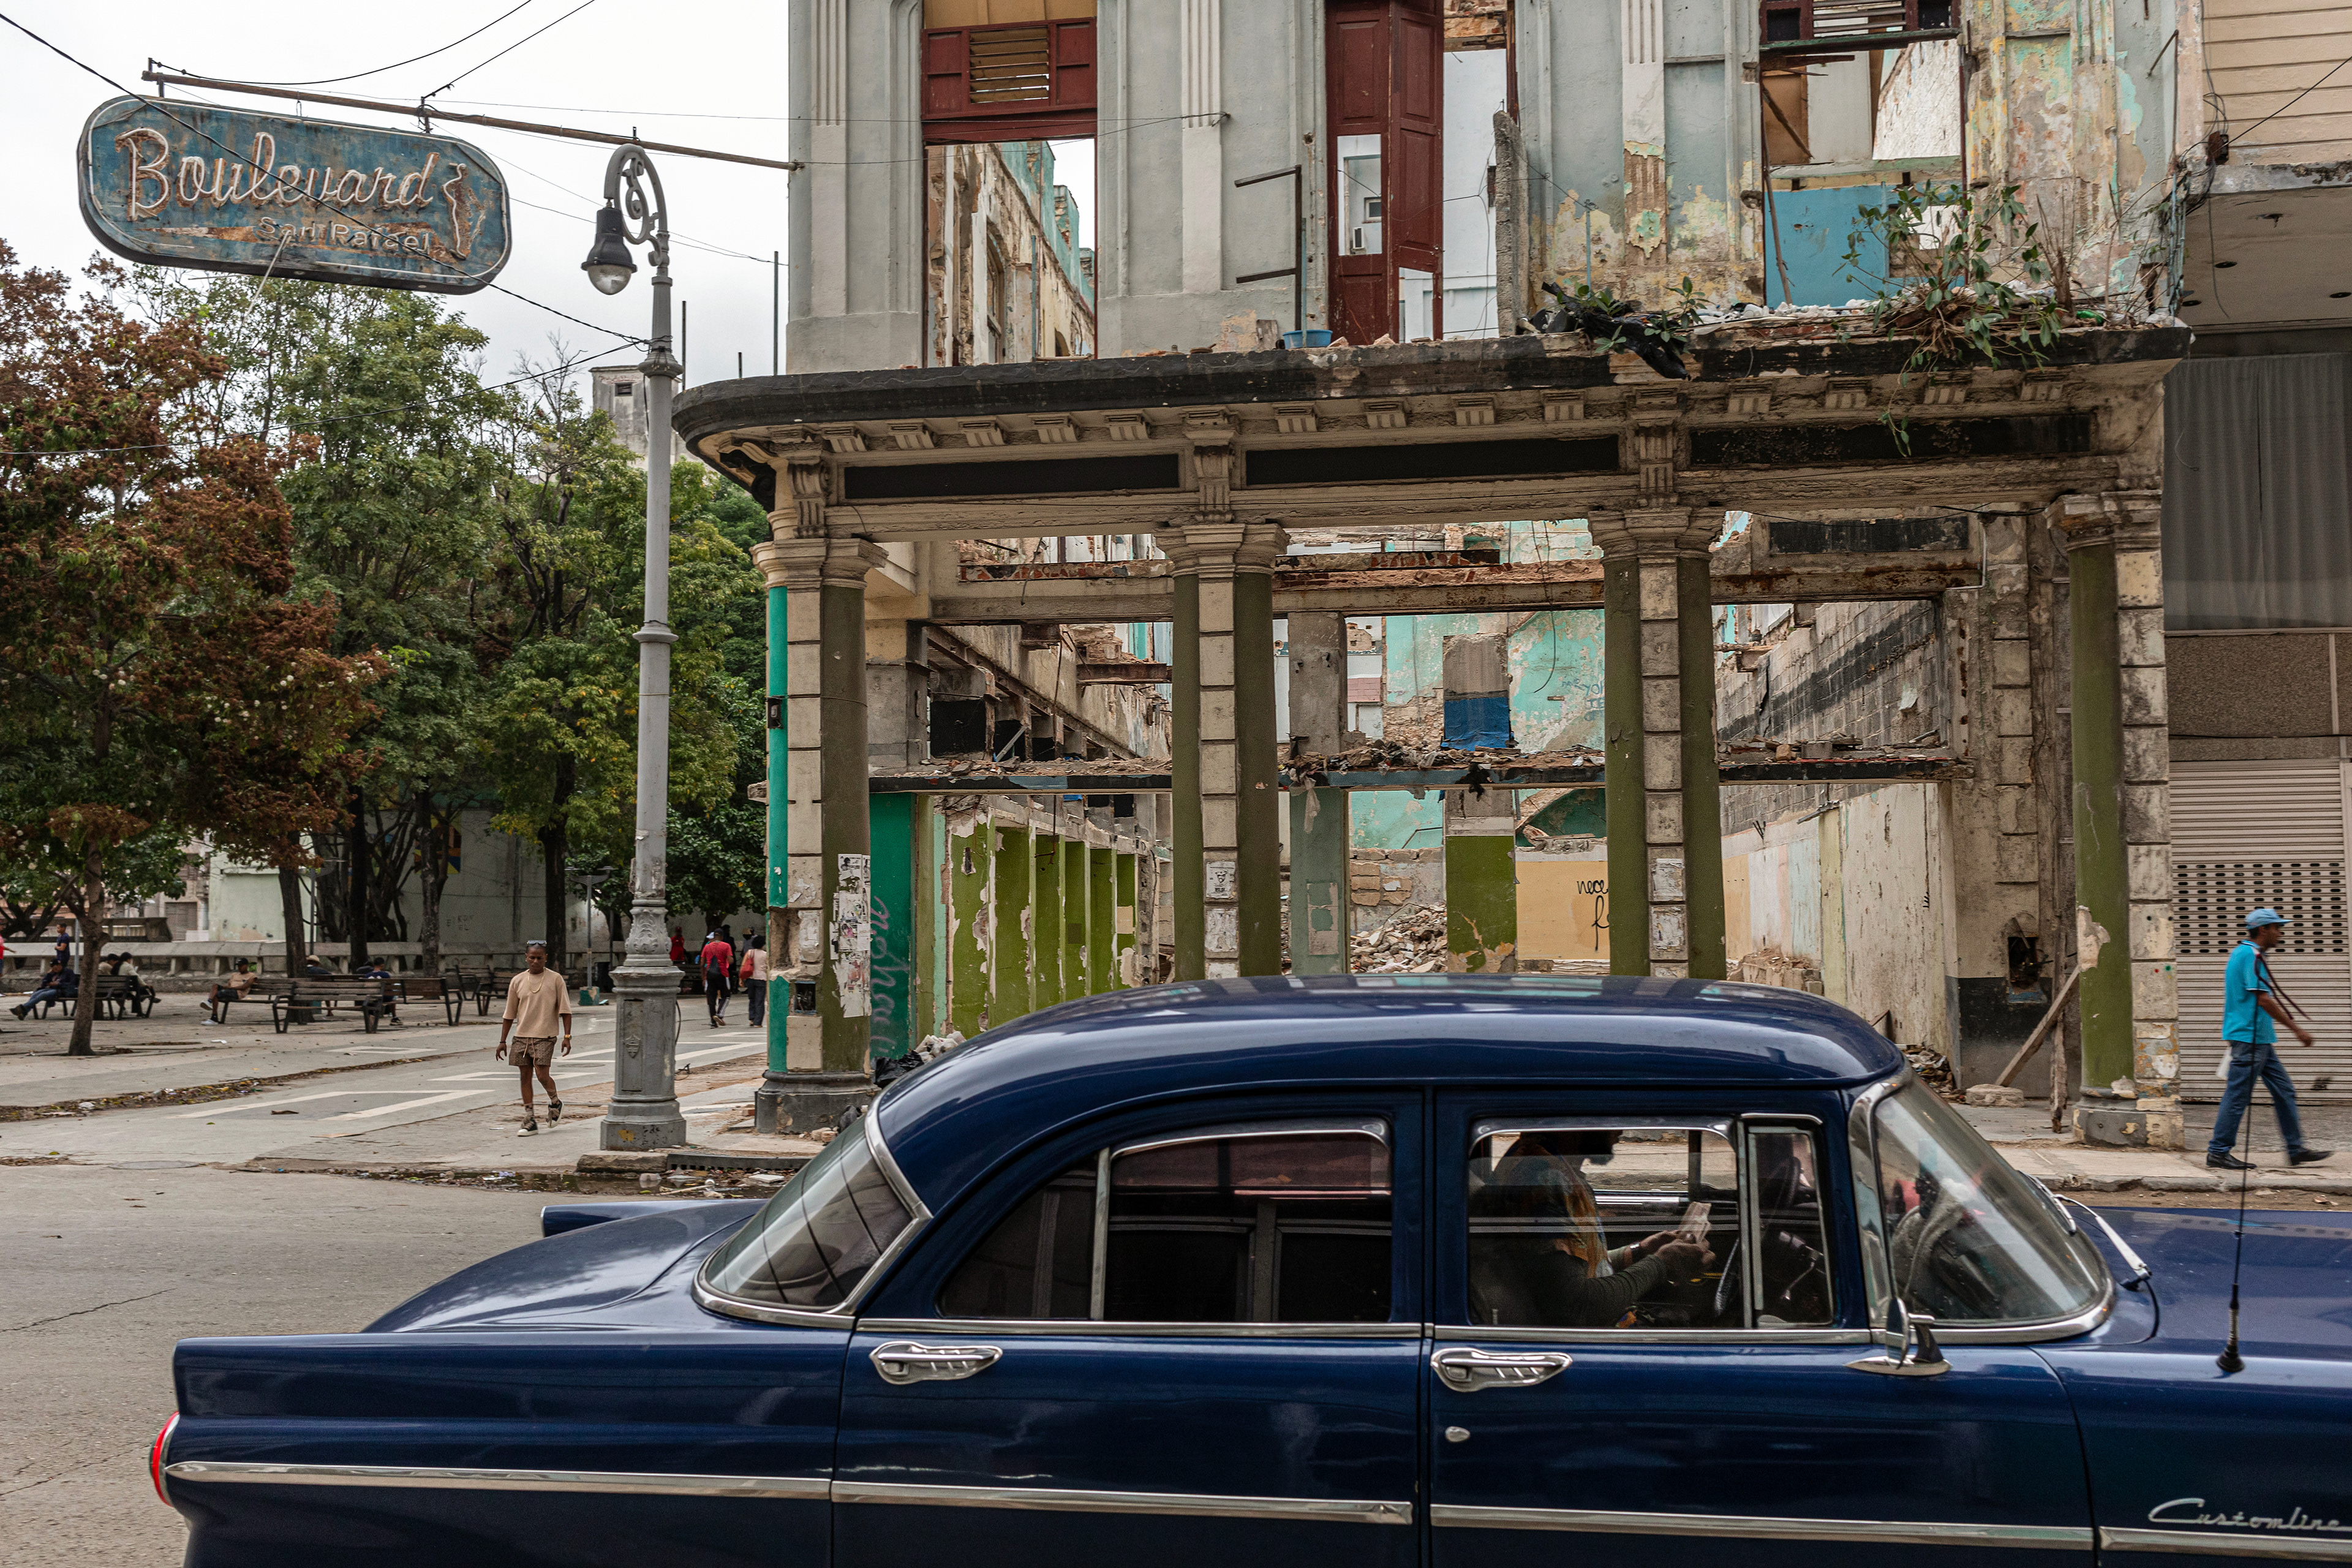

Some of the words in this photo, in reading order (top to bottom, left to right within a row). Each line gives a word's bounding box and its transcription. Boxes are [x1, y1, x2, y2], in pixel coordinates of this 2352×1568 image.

[115, 127, 440, 222] Boulevard
[253, 216, 317, 241] San
[327, 221, 430, 254] Rafael
[1577, 880, 1609, 894] nece
[2148, 1498, 2352, 1531] Customline
